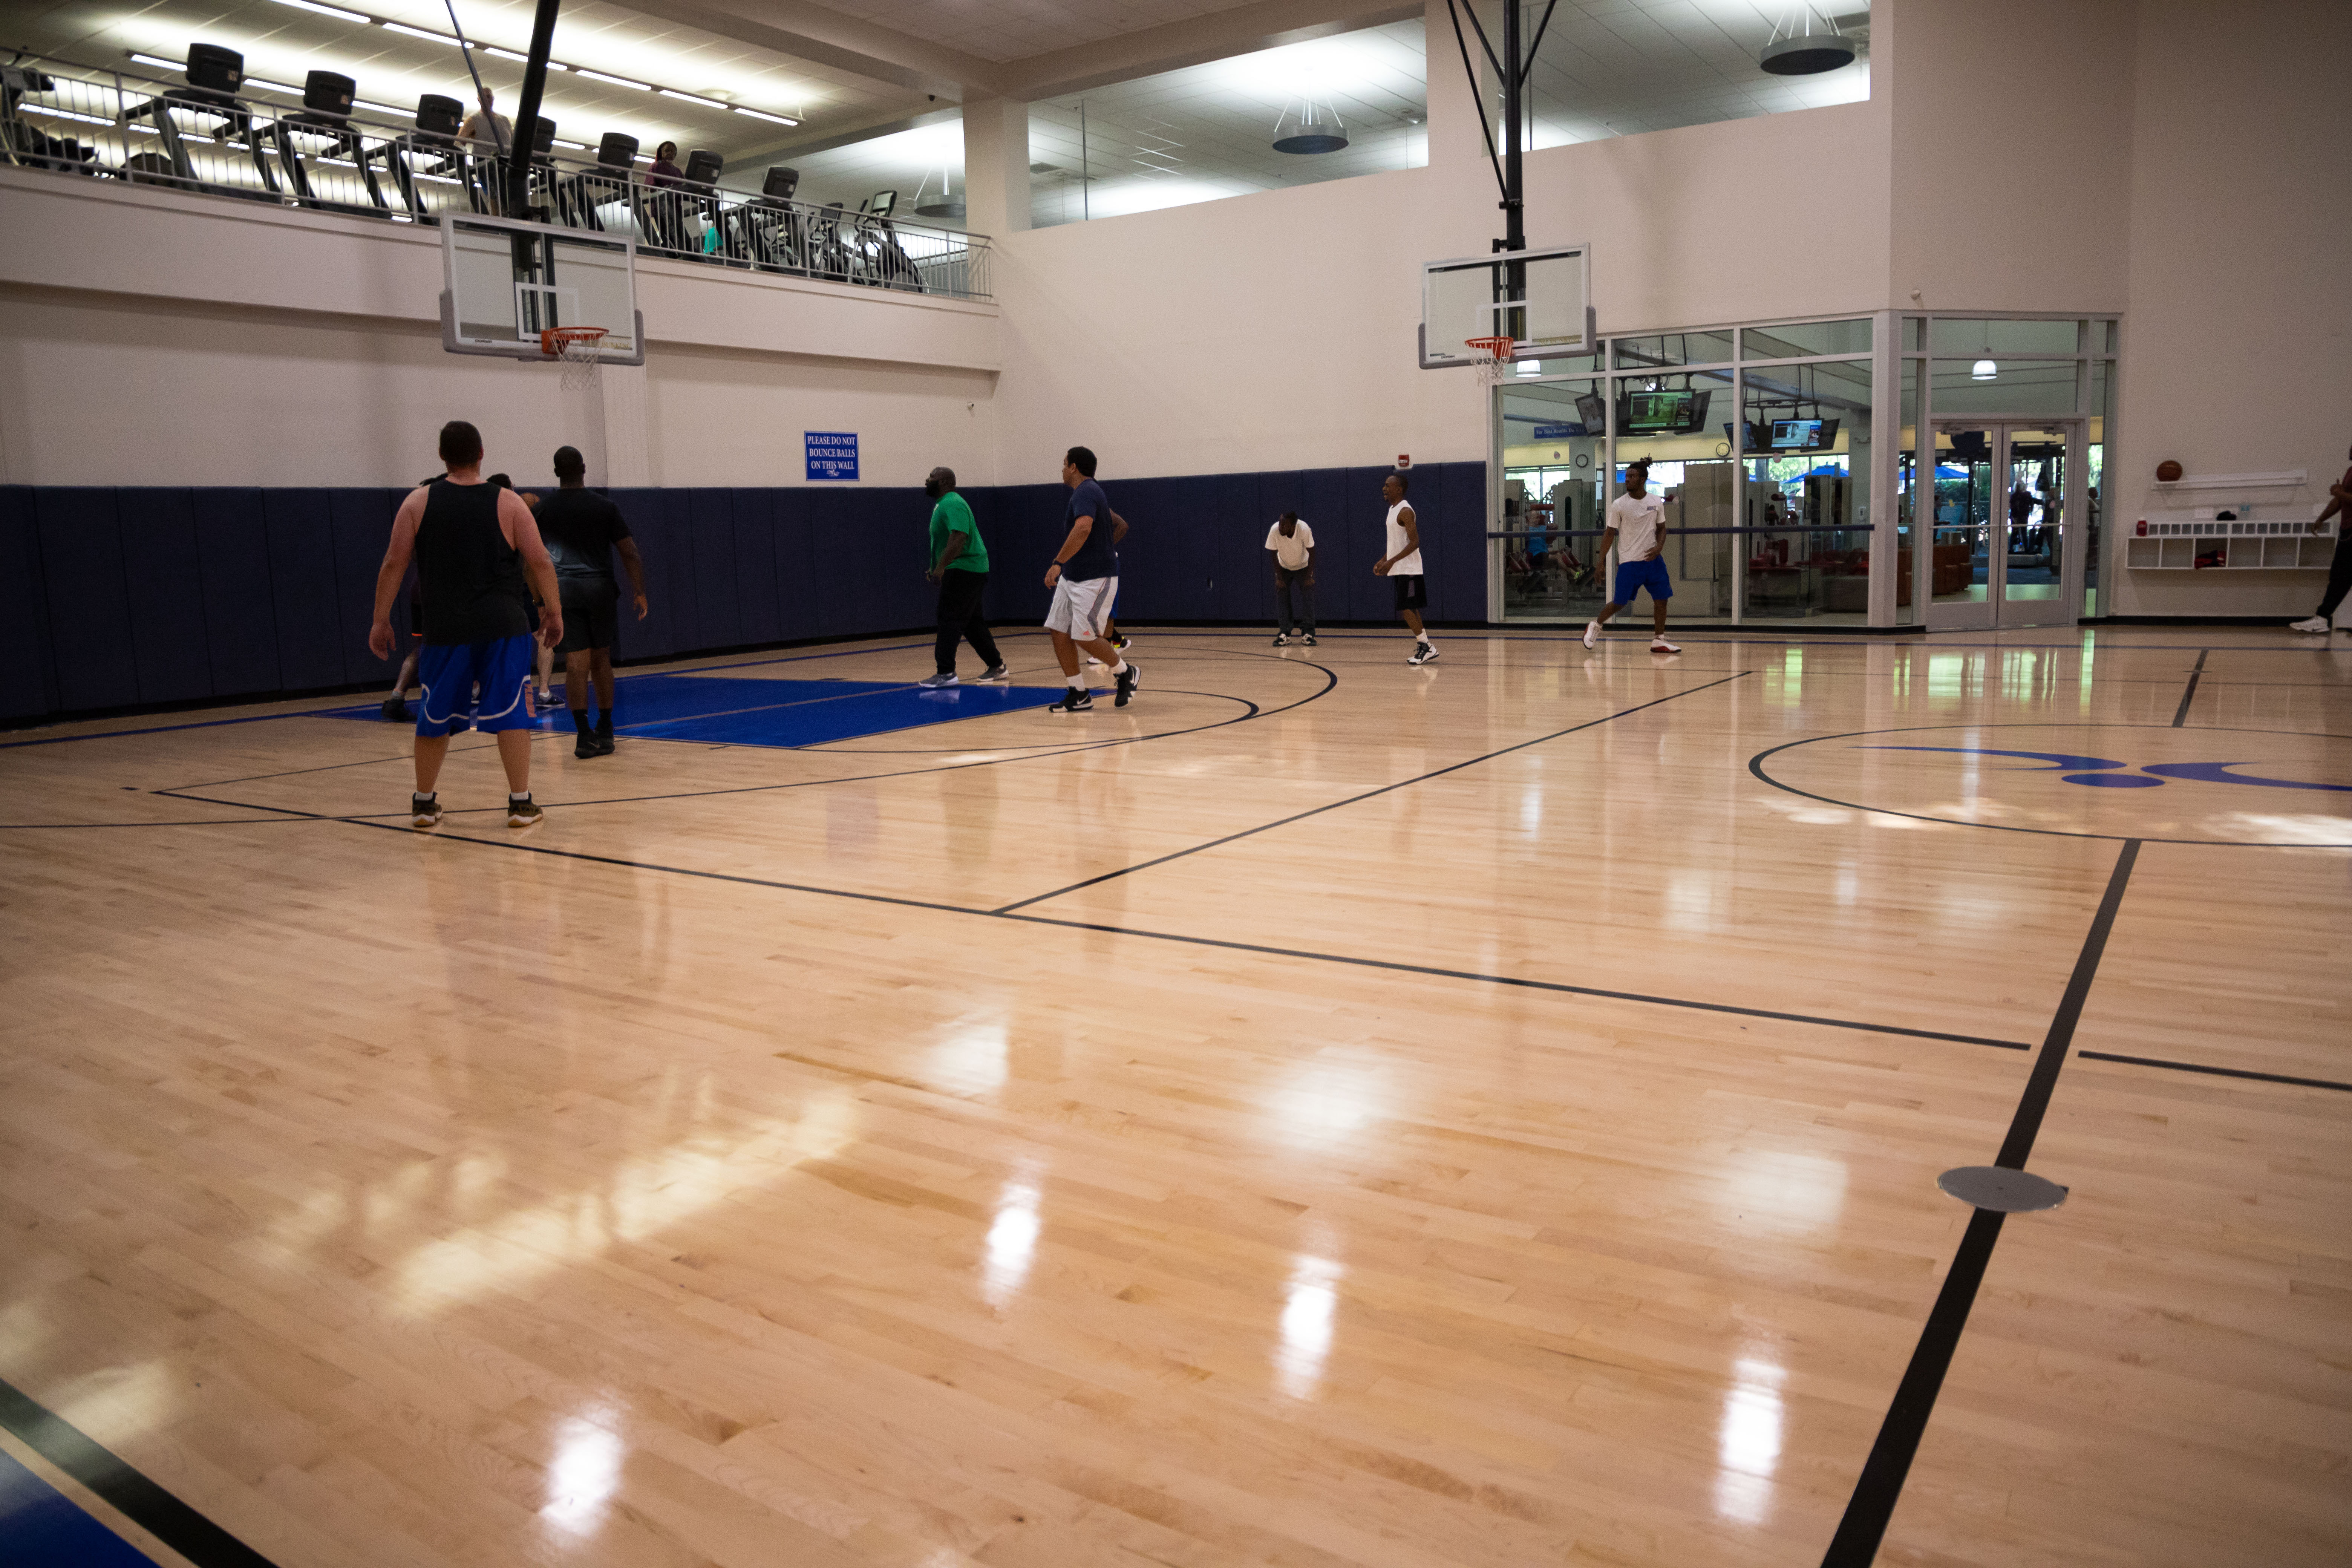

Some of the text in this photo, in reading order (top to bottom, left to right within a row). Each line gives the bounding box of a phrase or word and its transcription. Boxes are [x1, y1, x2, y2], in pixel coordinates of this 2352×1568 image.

[807, 436, 855, 445] PLEASE DO NOT
[809, 448, 855, 457] BOUNCE BALLS
[811, 460, 854, 469] ON THIS WALL
